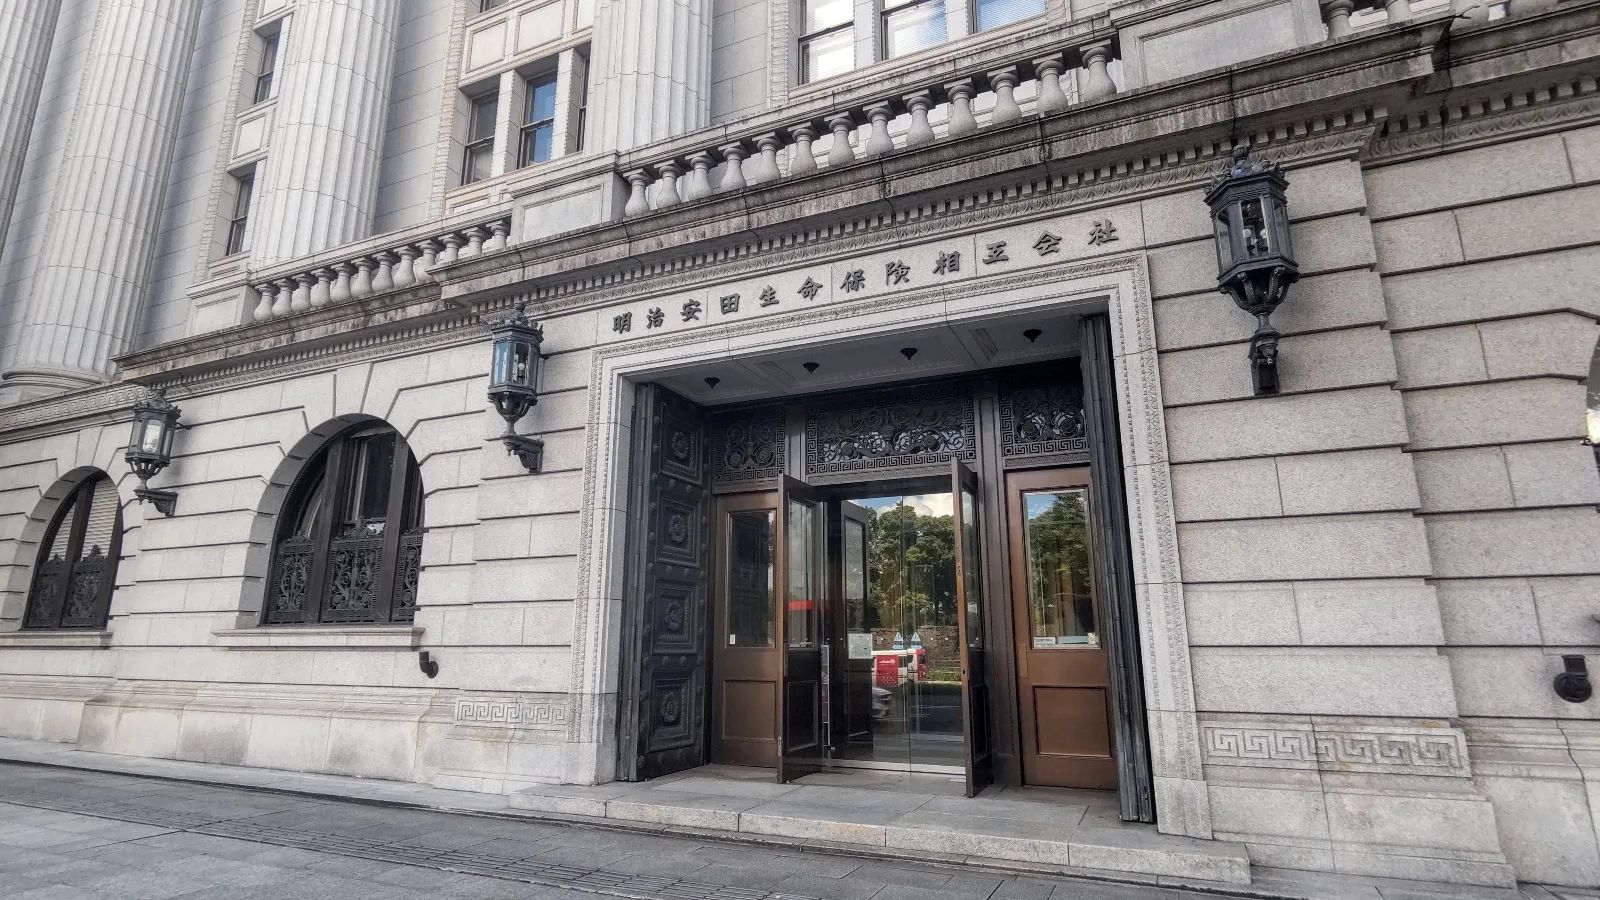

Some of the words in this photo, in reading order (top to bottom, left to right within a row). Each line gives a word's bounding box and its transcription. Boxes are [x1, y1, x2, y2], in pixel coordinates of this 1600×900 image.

[612, 219, 1119, 334] 明治安田生命保険相互会社
